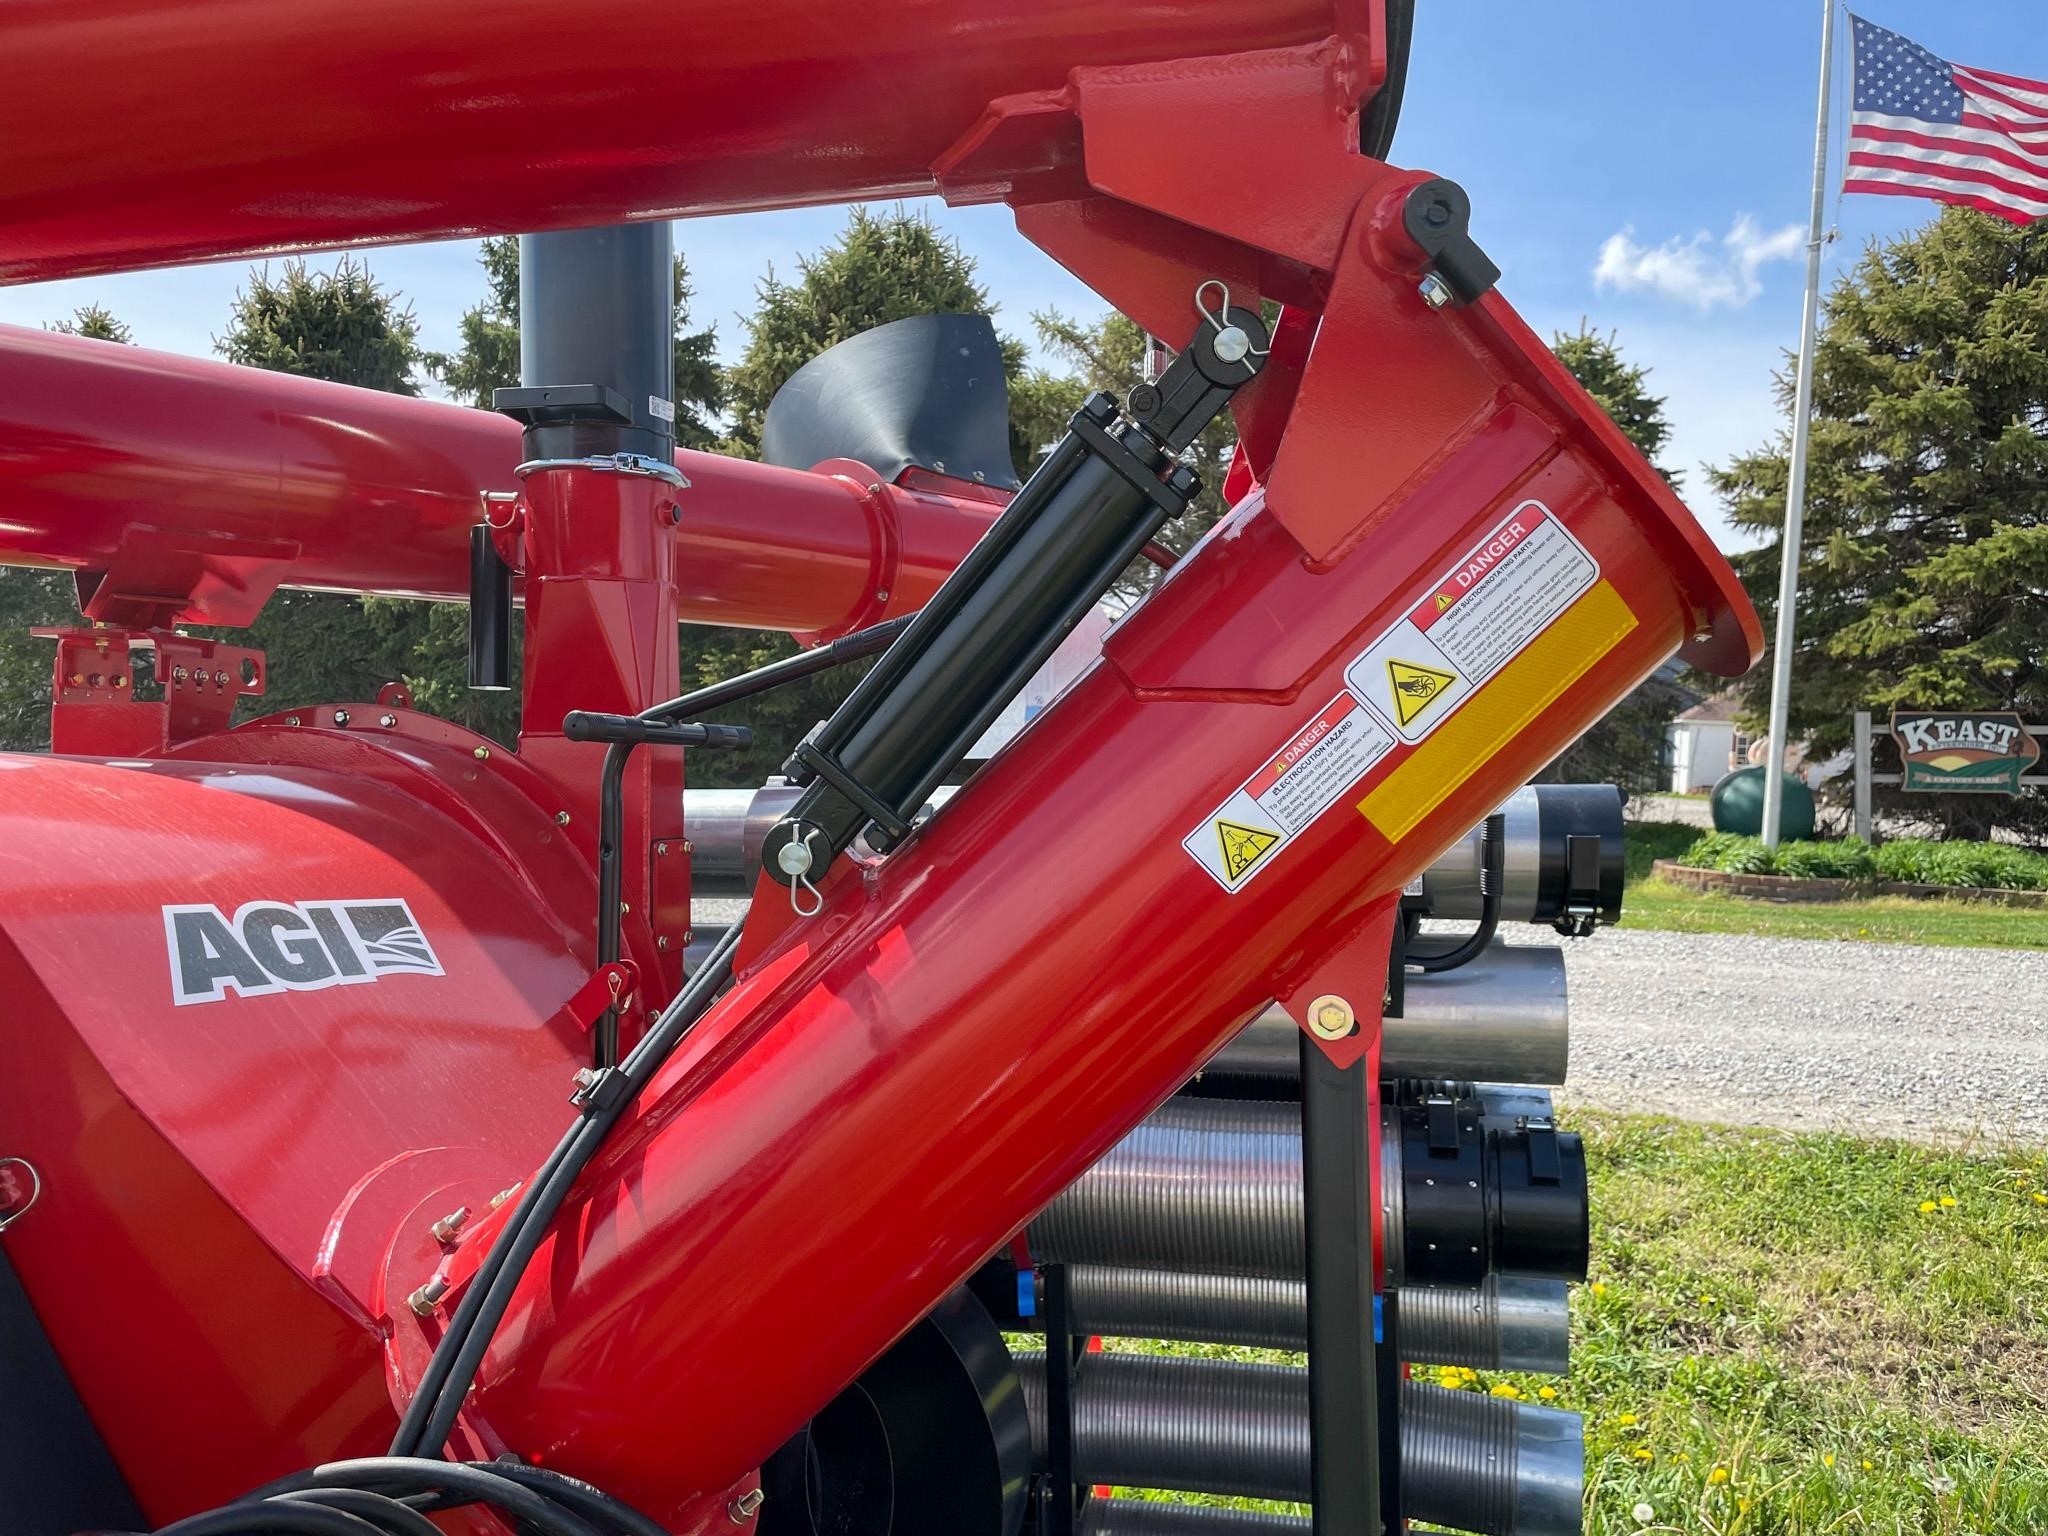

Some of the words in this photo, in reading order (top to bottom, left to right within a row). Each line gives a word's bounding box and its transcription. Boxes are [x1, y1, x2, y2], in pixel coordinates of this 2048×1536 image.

[1442, 622, 1457, 637] prevent
[1457, 611, 1470, 623] being
[1469, 599, 1483, 612] pulled
[1515, 554, 1531, 570] rotating
[1531, 541, 1545, 554] blower
[1446, 607, 1461, 620] HIGH
[1460, 558, 1514, 607] SUCTION/ROTATING
[1513, 540, 1532, 558] PARTS
[1456, 523, 1526, 588] DANGER
[1451, 640, 1463, 651] Keep
[1462, 625, 1479, 641] clothing
[1479, 617, 1487, 625] and
[1487, 602, 1504, 617] yourself
[1512, 584, 1523, 594] clear
[1523, 576, 1532, 584] and
[1532, 563, 1545, 576] others
[1546, 553, 1557, 564] away
[1557, 543, 1567, 553] from
[1461, 640, 1472, 650] open
[1472, 631, 1481, 640] inlet
[1481, 623, 1489, 631] and
[1490, 605, 1510, 624] discharge
[1462, 650, 1474, 661] Never
[1474, 640, 1486, 650] open
[1490, 625, 1501, 635] close
[1502, 605, 1523, 625] inspection
[1535, 581, 1549, 594] unless
[1549, 570, 1561, 581] grain
[1569, 555, 1577, 563] has
[1477, 648, 1486, 656] shut
[1506, 615, 1522, 630] moving
[1522, 605, 1533, 615] parts
[1533, 595, 1543, 605] have
[1544, 579, 1561, 595] stopped
[1506, 626, 1523, 642] warning
[1523, 617, 1533, 627] may
[1532, 606, 1544, 617] result
[1549, 588, 1564, 602] serious
[1272, 745, 1325, 795] ELECTROCUTION
[1324, 720, 1353, 747] HAZARD
[1279, 804, 1289, 814] Stay
[1289, 794, 1301, 805] away
[1300, 784, 1311, 794] from
[1311, 766, 1330, 784] overhead
[1330, 748, 1349, 766] electrical
[1349, 737, 1361, 748] wires
[1361, 726, 1373, 738] when
[1285, 719, 1329, 762] DANGER
[1898, 717, 2019, 754] KEAST
[1277, 786, 1296, 804] prevent
[1296, 769, 1313, 786] serious
[1313, 757, 1327, 770] injury
[1284, 801, 1303, 819] adjusting
[1303, 790, 1316, 802] auger
[1320, 770, 1337, 785] moving
[1290, 800, 1317, 824] Electrocution
[1317, 792, 1325, 800] can
[1325, 781, 1337, 792] occur
[1337, 767, 1353, 781] without
[171, 905, 369, 997] AGI
